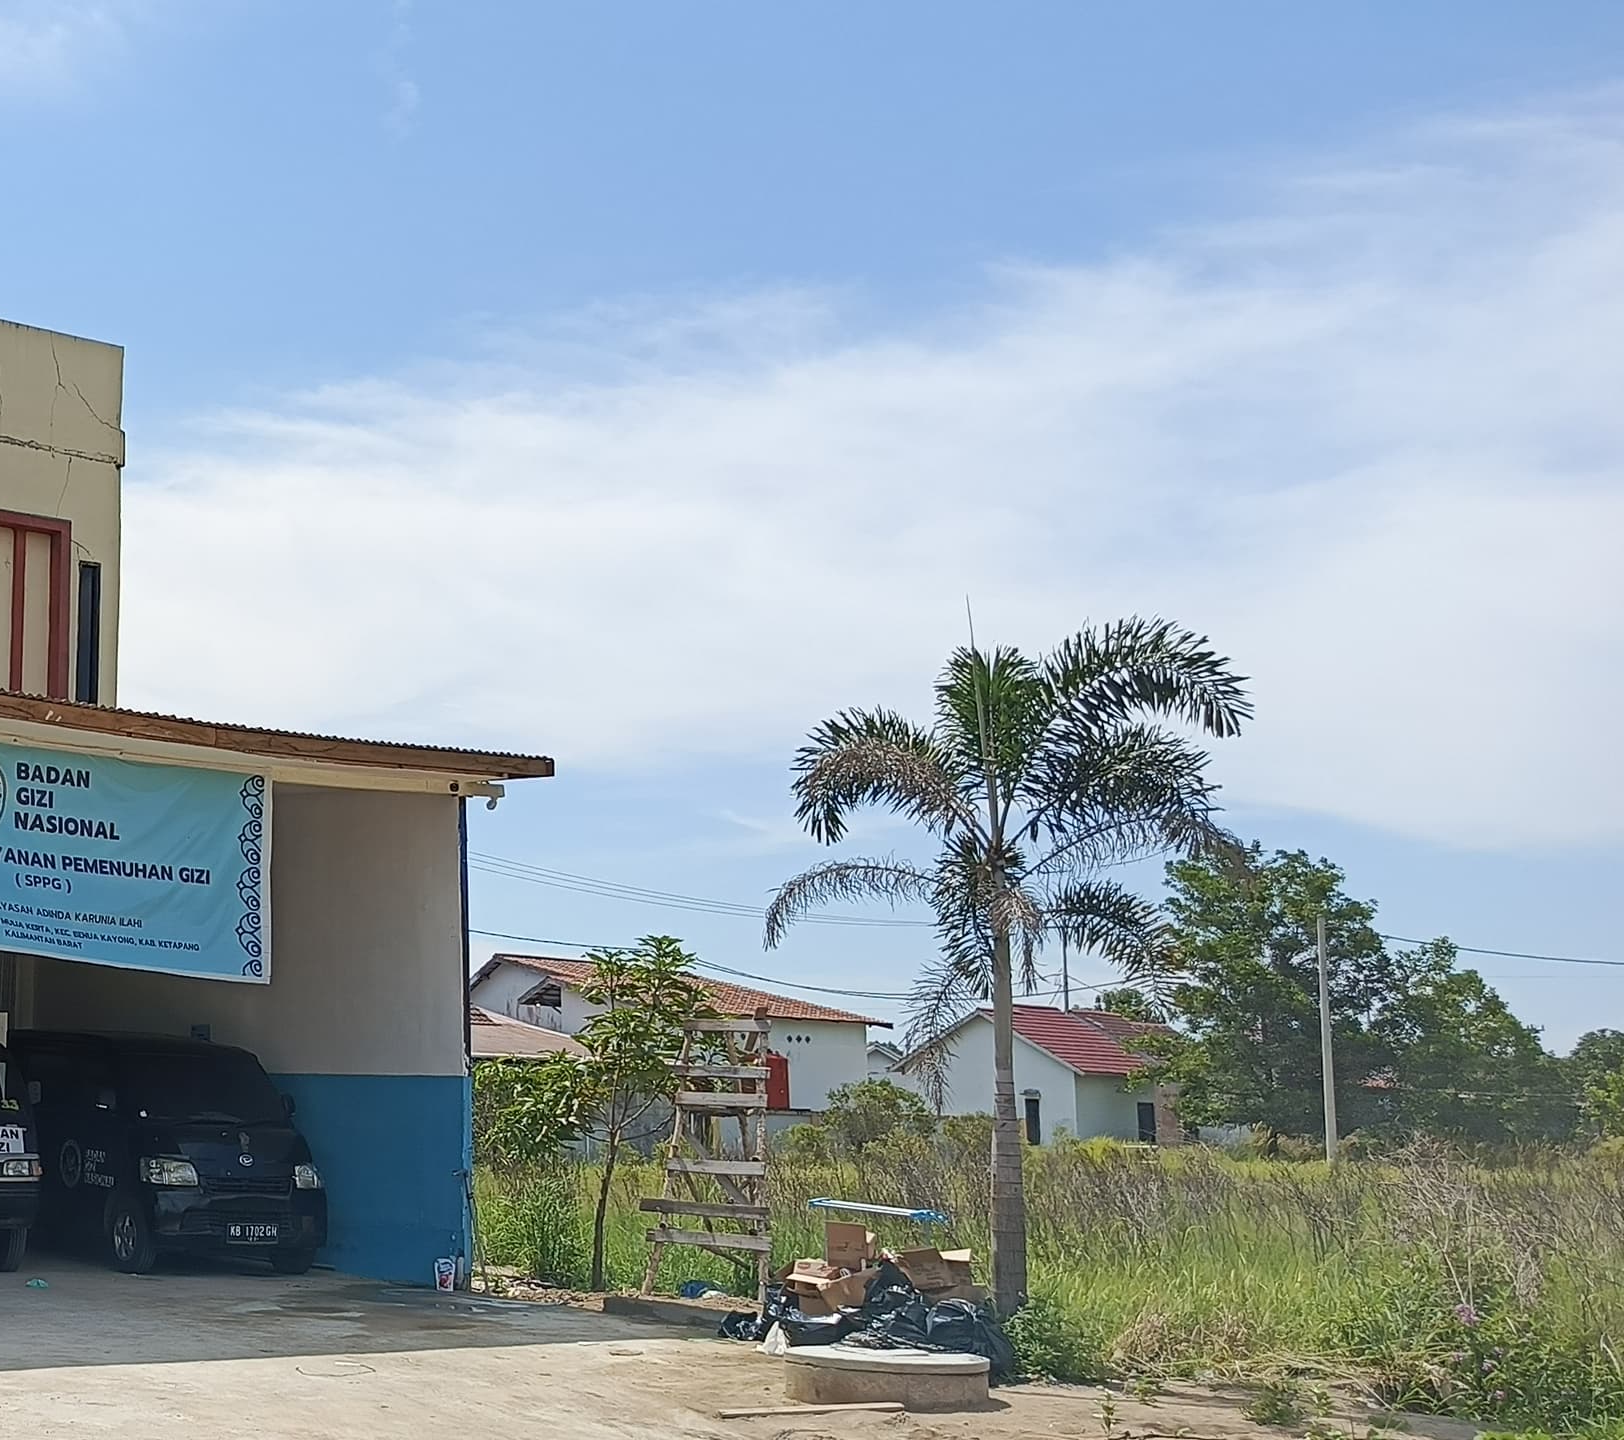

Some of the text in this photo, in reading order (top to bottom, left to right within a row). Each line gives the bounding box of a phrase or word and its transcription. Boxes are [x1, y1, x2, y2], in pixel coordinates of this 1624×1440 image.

[16, 762, 90, 788] BADAN
[15, 787, 54, 809] GIZI
[14, 811, 120, 841] NASIONAL
[61, 855, 174, 882] PEMENUHAN
[178, 866, 211, 885] GIZI
[25, 874, 62, 890] SPPG
[36, 907, 72, 921] ADINDA
[74, 911, 117, 926] KARUNIA
[119, 917, 143, 929] ILAHI
[157, 940, 201, 952] KETAPANG
[230, 1225, 241, 1237] KB
[246, 1225, 265, 1237] 1702
